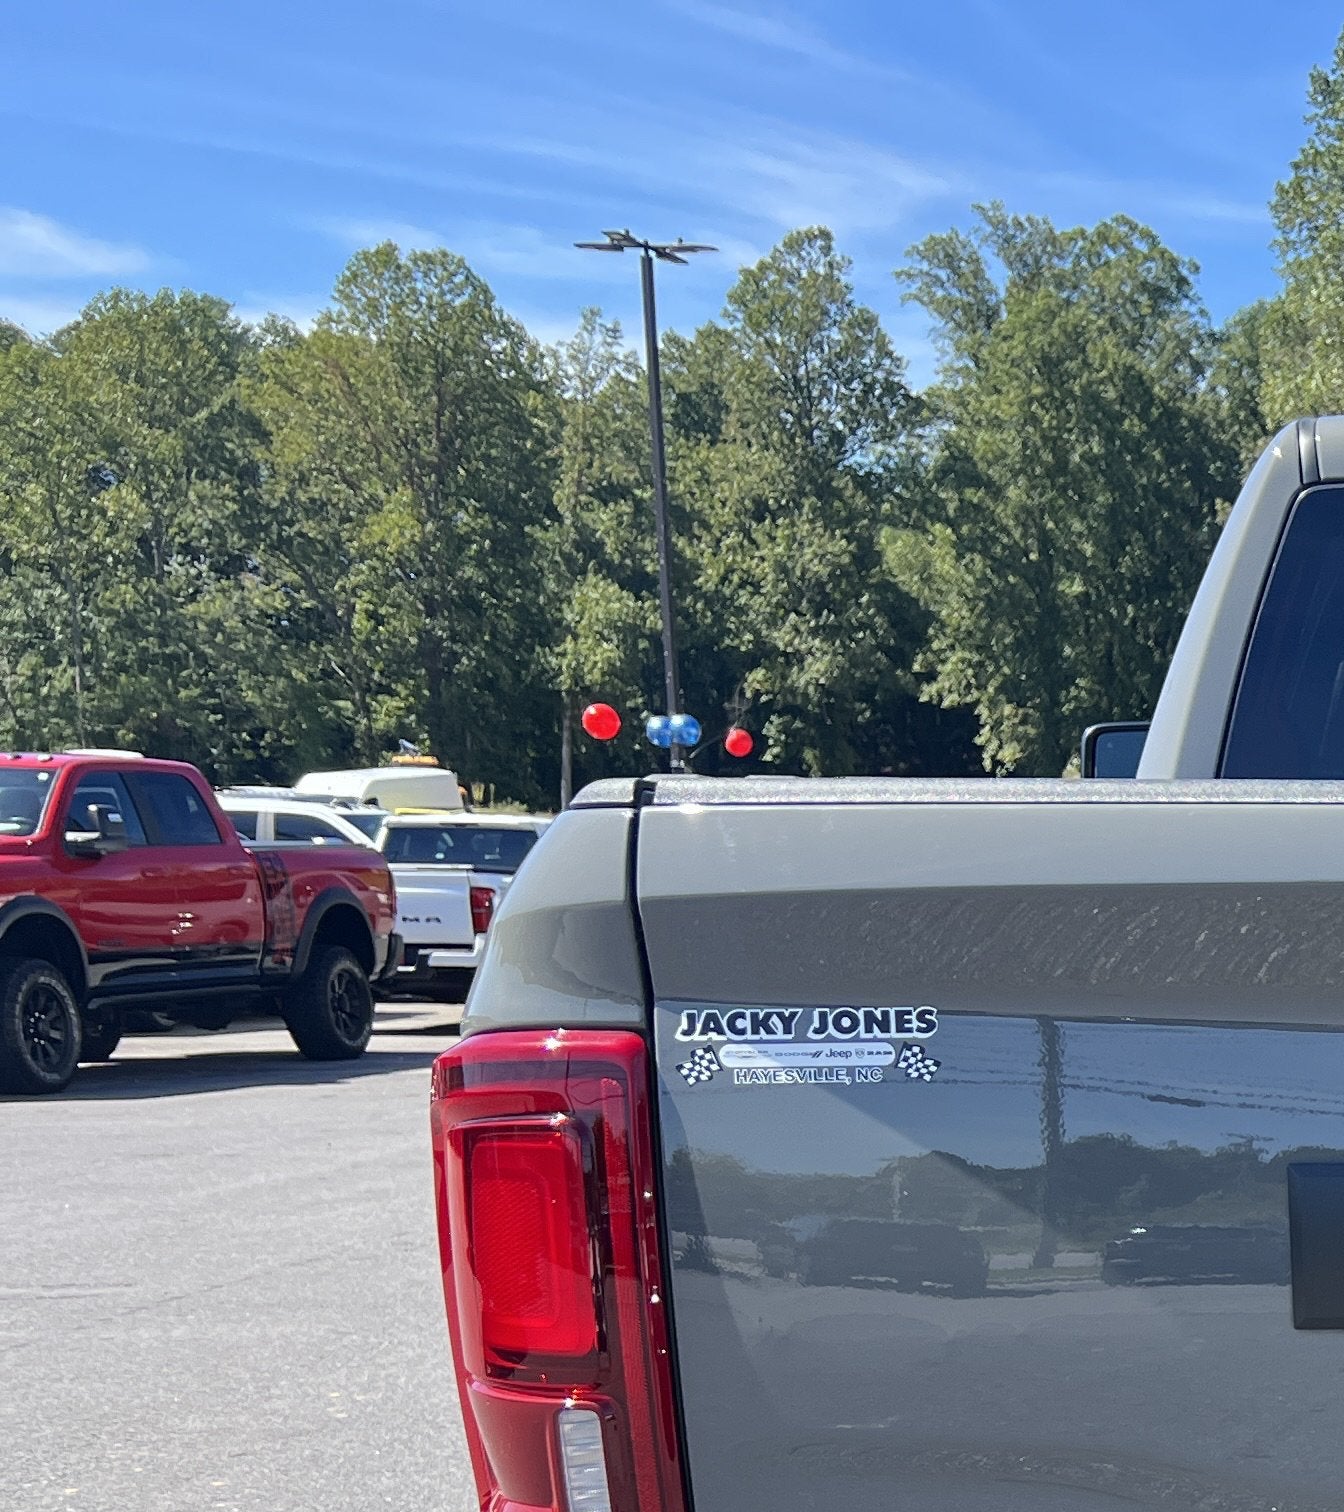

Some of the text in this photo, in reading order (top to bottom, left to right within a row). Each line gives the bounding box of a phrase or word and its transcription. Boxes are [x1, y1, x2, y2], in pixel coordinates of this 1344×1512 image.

[675, 1006, 939, 1041] JACKY JONES
[825, 1048, 853, 1059] Jeep
[734, 1066, 883, 1085] HAYESVILLE, NC
